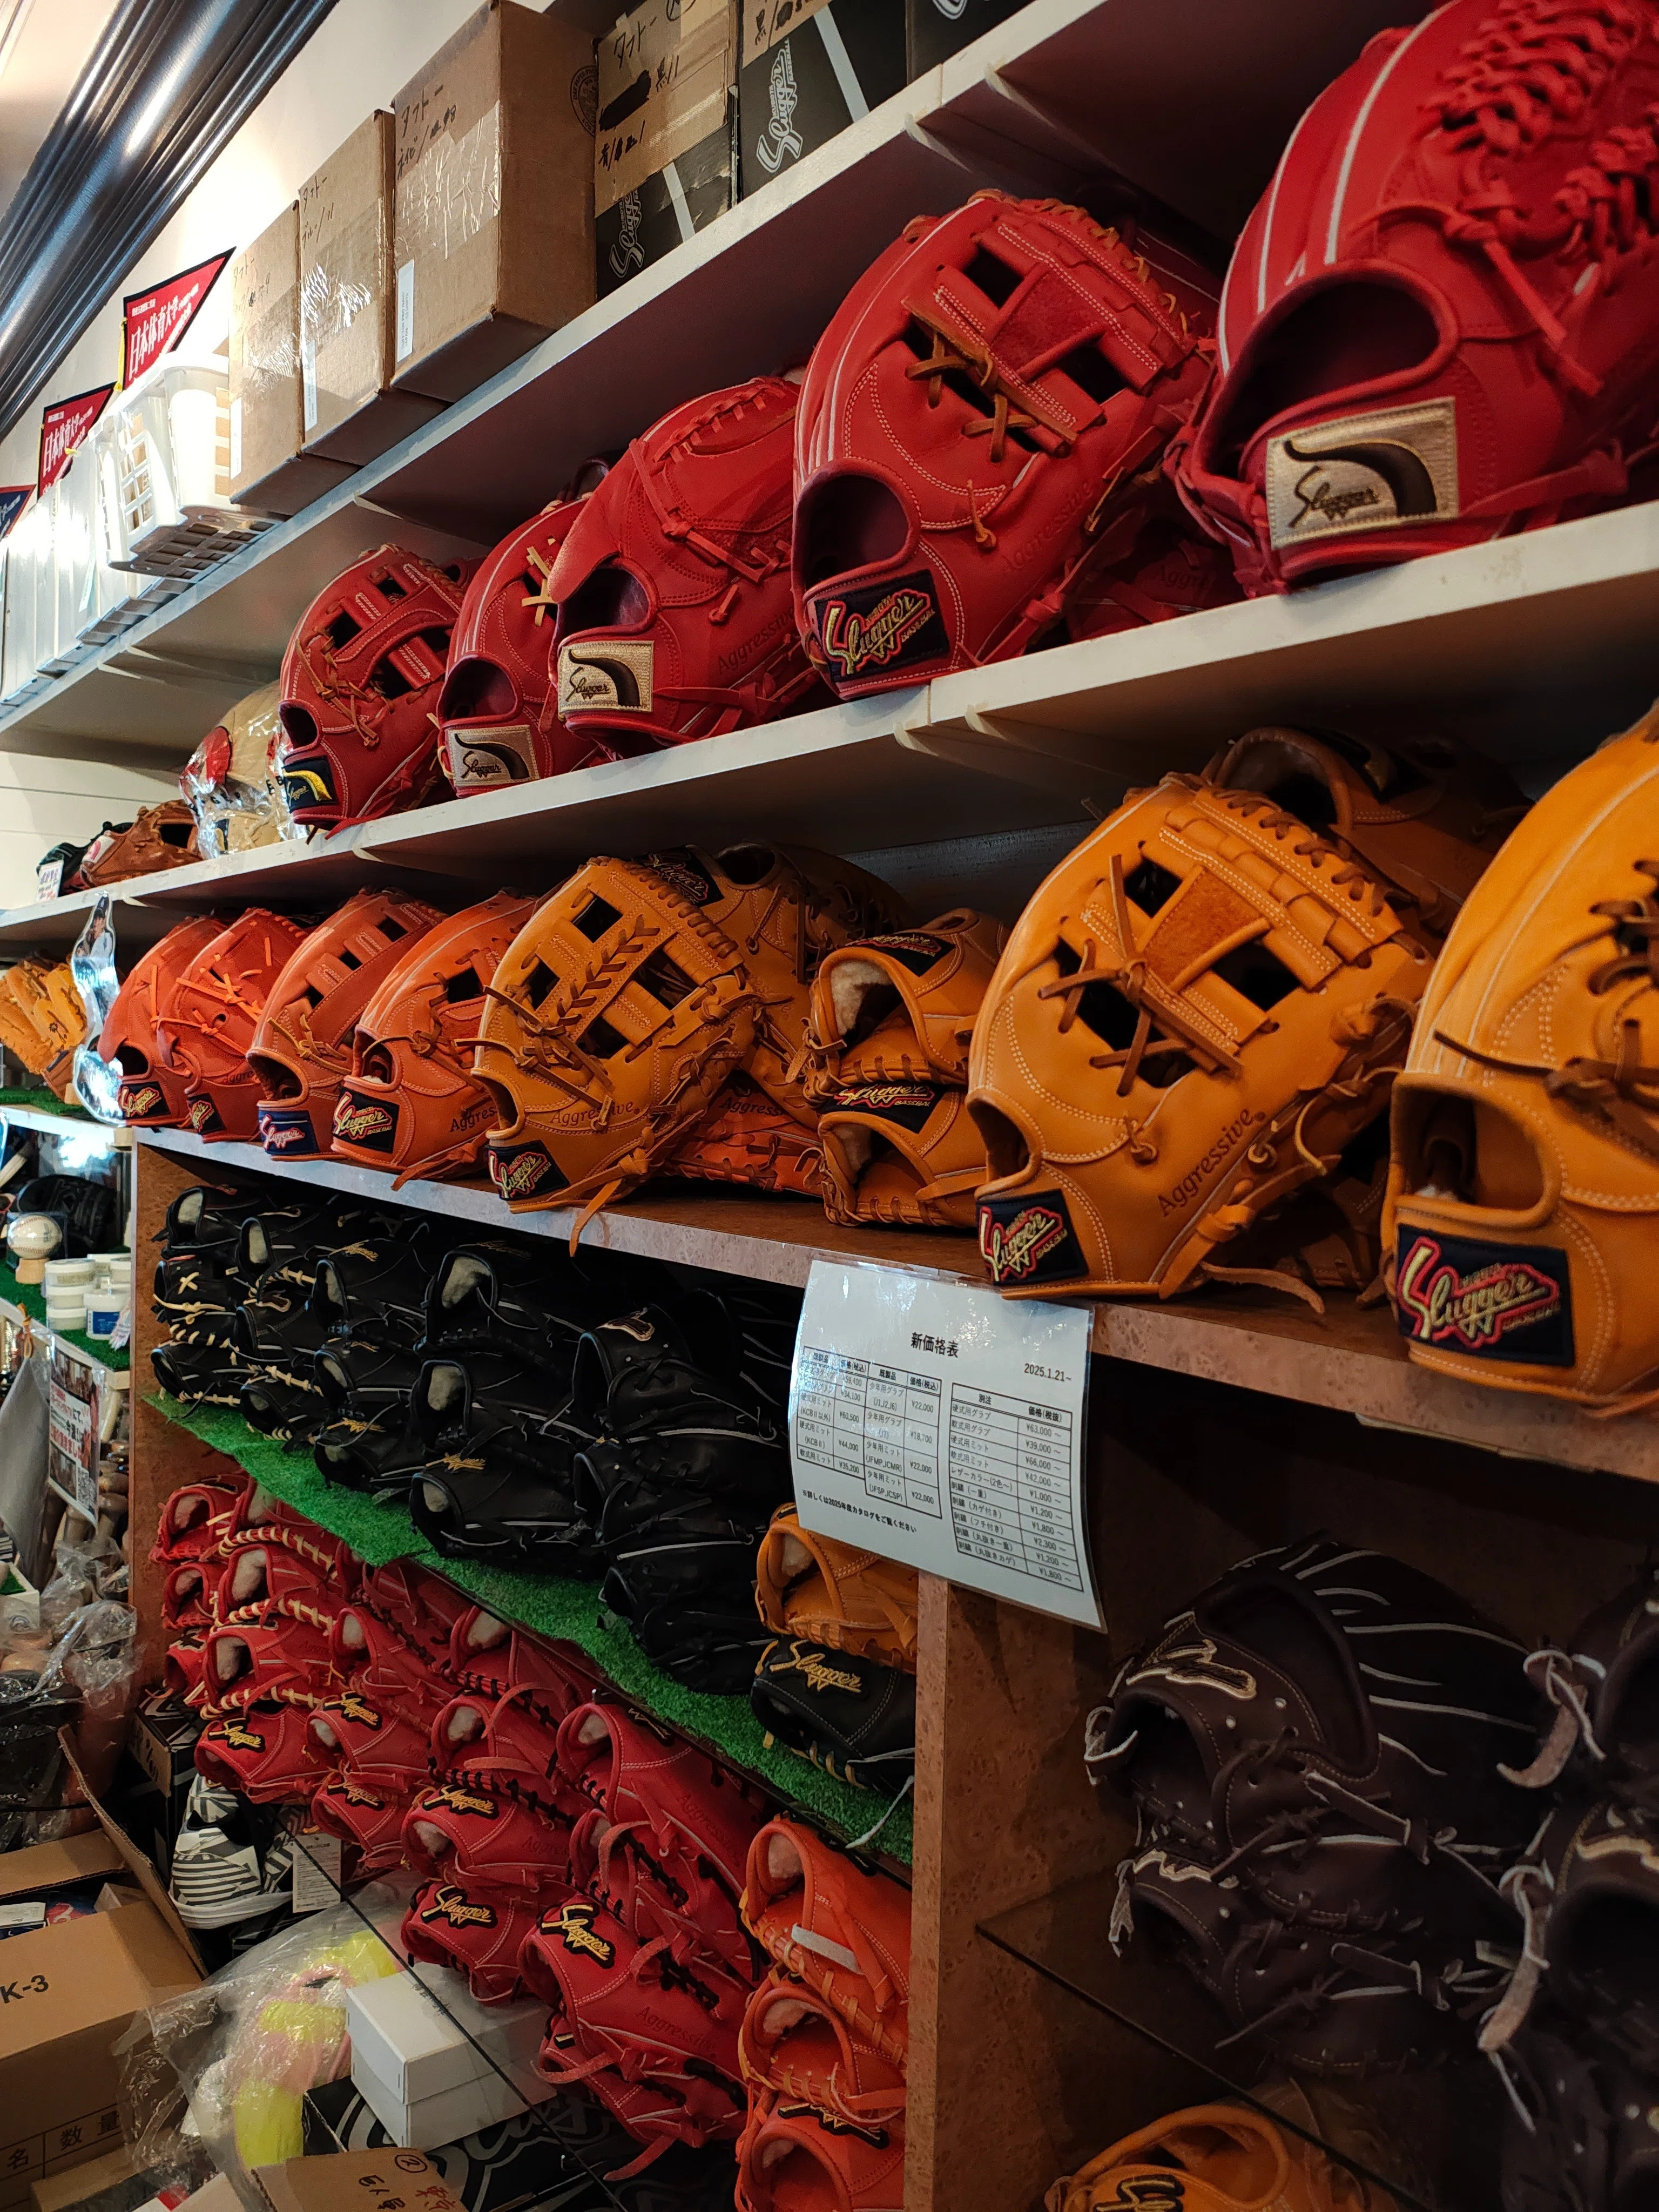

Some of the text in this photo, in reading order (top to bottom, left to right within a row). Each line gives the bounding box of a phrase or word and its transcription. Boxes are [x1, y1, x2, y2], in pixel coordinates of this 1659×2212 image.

[769, 85, 778, 117] KUBOTA
[756, 48, 803, 173] Slugger
[825, 593, 926, 675] Slugger
[565, 666, 611, 702] Slugger
[460, 750, 502, 779] Slugger
[335, 1091, 390, 1136] Slugger
[1158, 1108, 1253, 1218] Aggressive
[489, 1153, 545, 1198] Slugger
[980, 1210, 1054, 1282] Slugger
[1401, 1243, 1553, 1342] Slugger
[911, 1331, 959, 1358] 新価格表
[879, 1369, 896, 1381] 既製品
[869, 1382, 904, 1397] 少年用グラブ
[910, 1377, 939, 1392] 価格(税込)
[912, 1399, 934, 1413] ¥22,000
[979, 1393, 992, 1405] 別注
[839, 1411, 860, 1423] ¥60,500
[867, 1411, 902, 1426] 少年用グラブ
[952, 1403, 992, 1420] 硬式用グラブ
[1027, 1422, 1052, 1437] ¥63,000
[1028, 1406, 1062, 1423] 価格(税抜)
[799, 1420, 830, 1435] 硬式用ミット
[951, 1419, 990, 1437] 軟式用グラブ
[1026, 1440, 1051, 1454] ¥39,000
[839, 1439, 859, 1452] ¥44,000
[866, 1441, 901, 1457] 少年用ミット
[950, 1434, 988, 1451] 硬式用ミット
[1026, 1456, 1051, 1470] ¥66,000
[800, 1448, 831, 1465] 軟式用ミット
[839, 1461, 859, 1474] ¥35,200
[910, 1461, 933, 1474] ¥22,000
[867, 1470, 901, 1486] 少年用ミット
[1026, 1473, 1051, 1487] ¥42,000
[912, 1491, 934, 1505] ¥22,000
[1030, 1489, 1052, 1503] ¥1,000
[1030, 1505, 1053, 1519] ¥1,200
[1031, 1521, 1055, 1535] ¥1,800
[1034, 1536, 1057, 1551] ¥2,300
[423, 1784, 495, 1814] Slugger
[422, 1885, 493, 1924] Slugger
[541, 1904, 611, 1961] Slugger
